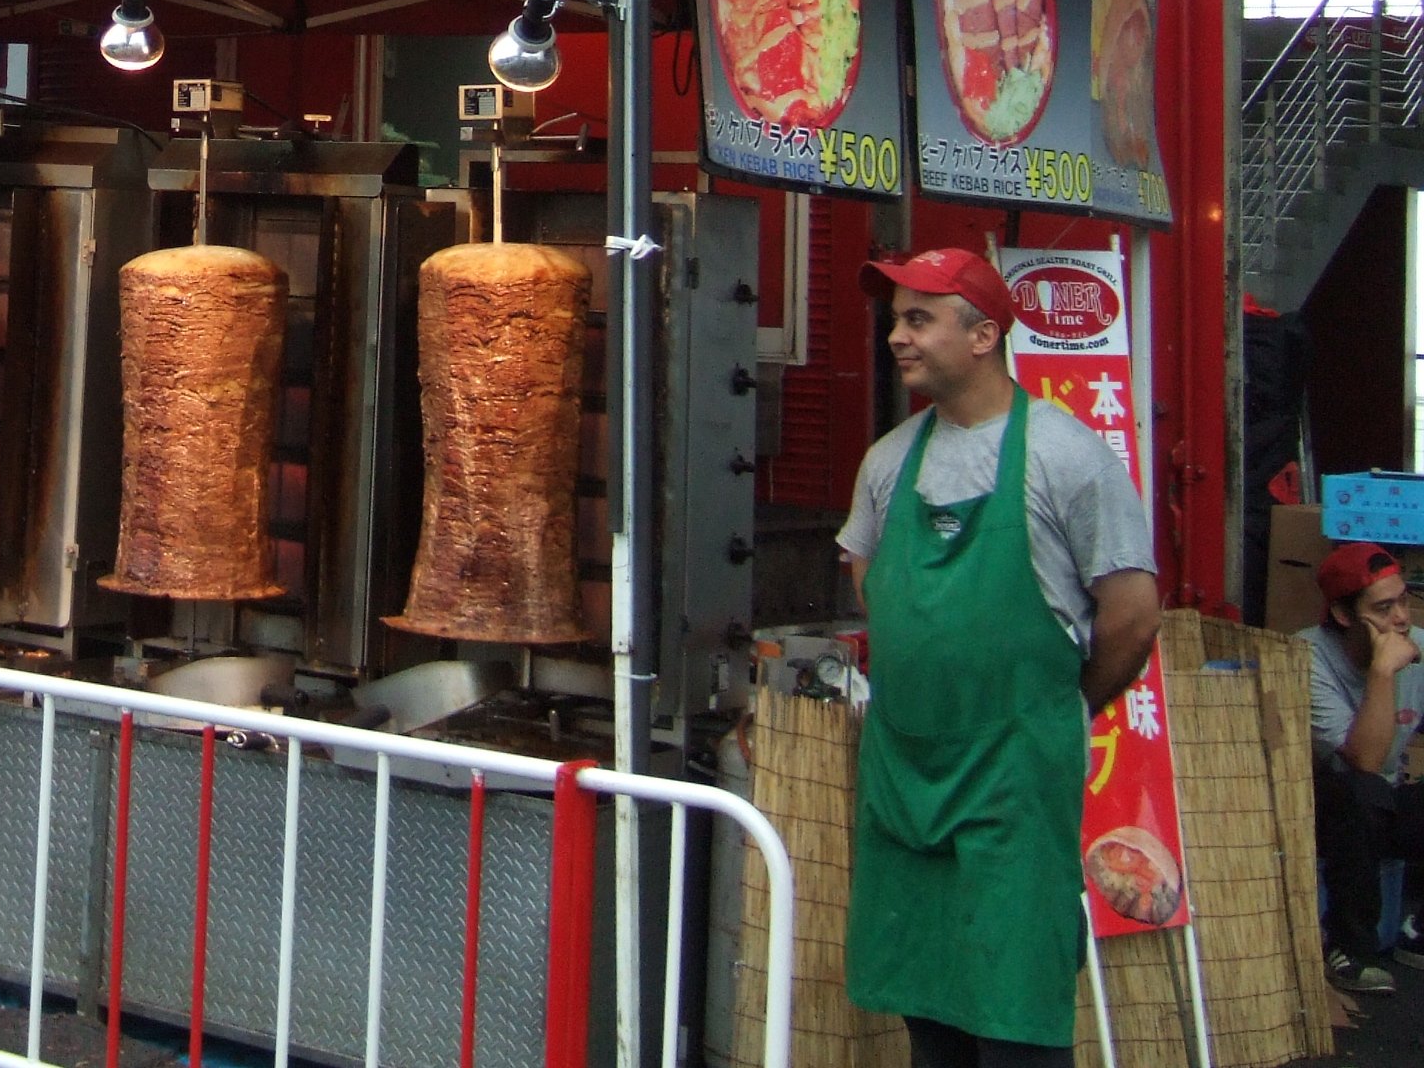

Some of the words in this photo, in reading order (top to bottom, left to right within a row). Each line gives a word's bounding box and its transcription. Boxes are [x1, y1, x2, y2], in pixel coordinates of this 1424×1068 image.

[769, 121, 816, 159] ライス
[740, 152, 778, 174] KEBAB
[783, 162, 816, 181] RICE
[816, 128, 898, 192] ¥500
[989, 145, 1022, 176] ライス
[922, 169, 948, 188] BEEF
[951, 173, 990, 193] KEBAB
[993, 180, 1022, 197] RICE
[1024, 147, 1092, 203] ¥500
[1071, 258, 1096, 270] ROAST
[1041, 310, 1084, 325] Time
[1029, 334, 1109, 350] donertime.com
